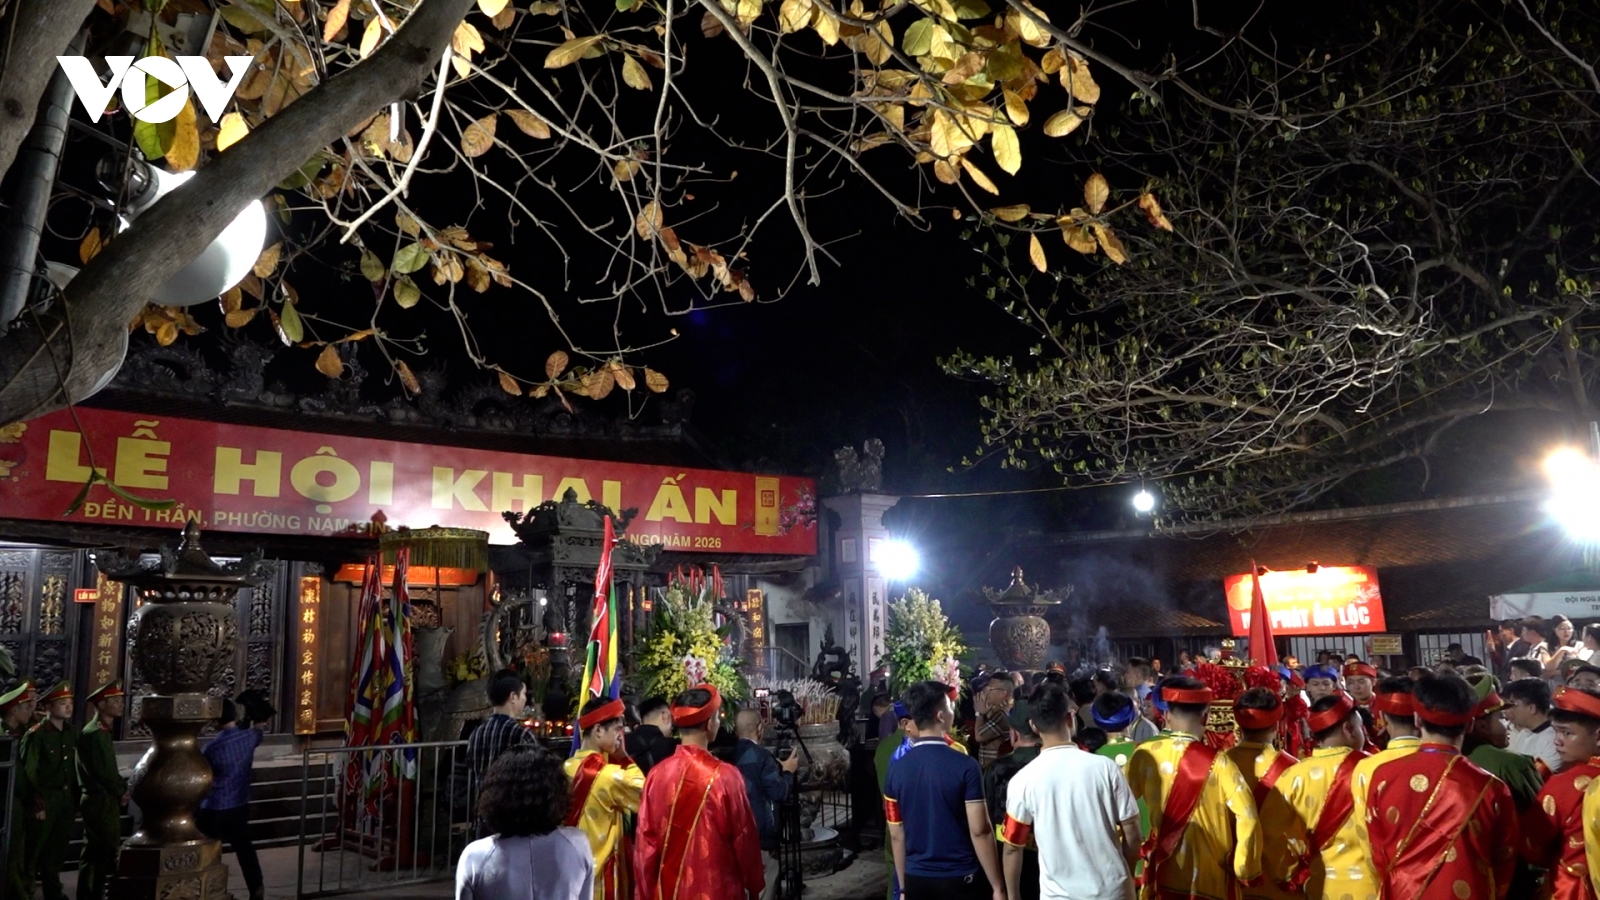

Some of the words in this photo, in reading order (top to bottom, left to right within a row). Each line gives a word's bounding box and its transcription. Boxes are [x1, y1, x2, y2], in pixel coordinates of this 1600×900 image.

[46, 420, 171, 490] LỄ
[213, 446, 394, 514] HỘI
[431, 466, 621, 520] KHAI
[645, 473, 737, 526] ẤN
[84, 498, 133, 520] ĐỀN
[214, 510, 300, 529] PHƯỜNG
[307, 517, 349, 531] NAM
[356, 520, 391, 536] ĐỊN
[663, 533, 691, 547] NĂM
[694, 536, 722, 549] 2026
[1338, 603, 1370, 629] LỘC
